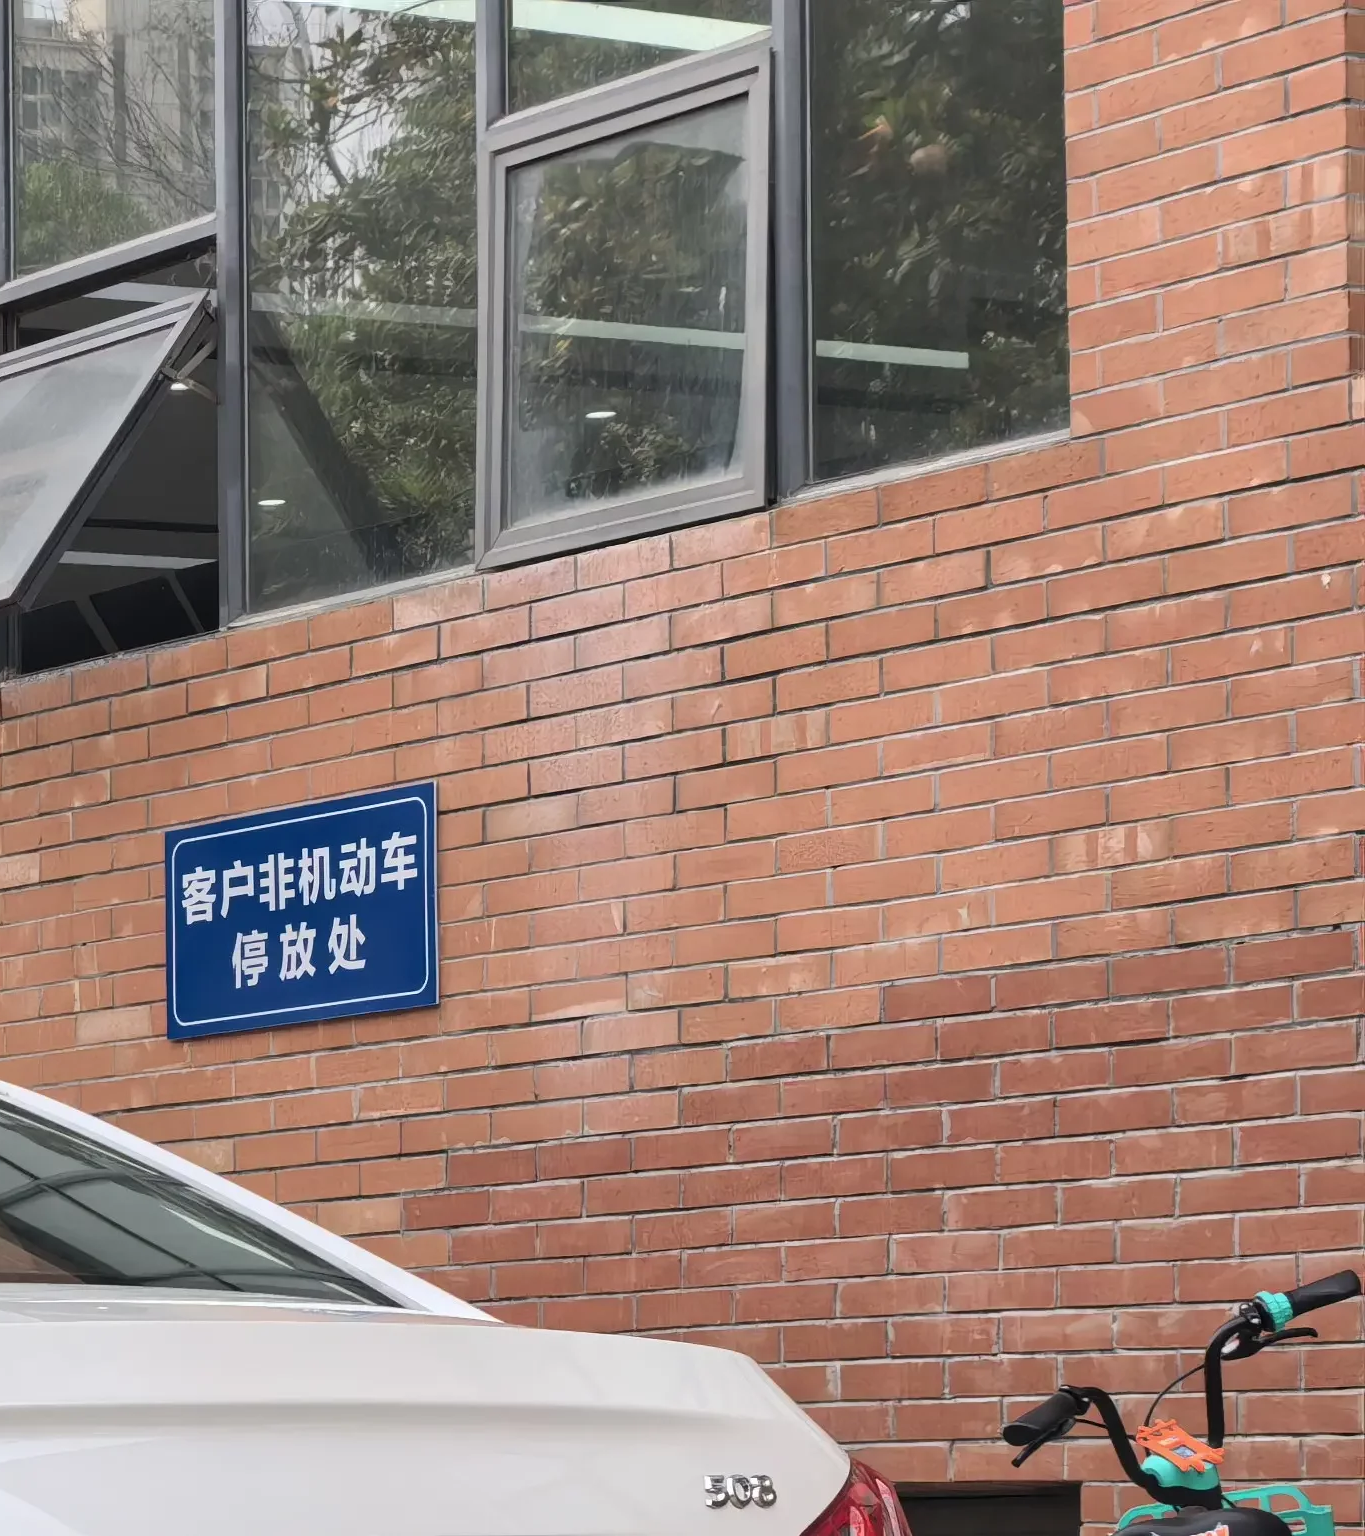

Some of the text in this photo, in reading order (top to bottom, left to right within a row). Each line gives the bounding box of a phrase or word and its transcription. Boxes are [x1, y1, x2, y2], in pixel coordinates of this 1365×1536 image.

[181, 831, 418, 926] 客户非机动车
[231, 913, 367, 989] 停放处
[703, 1474, 778, 1509] 508
